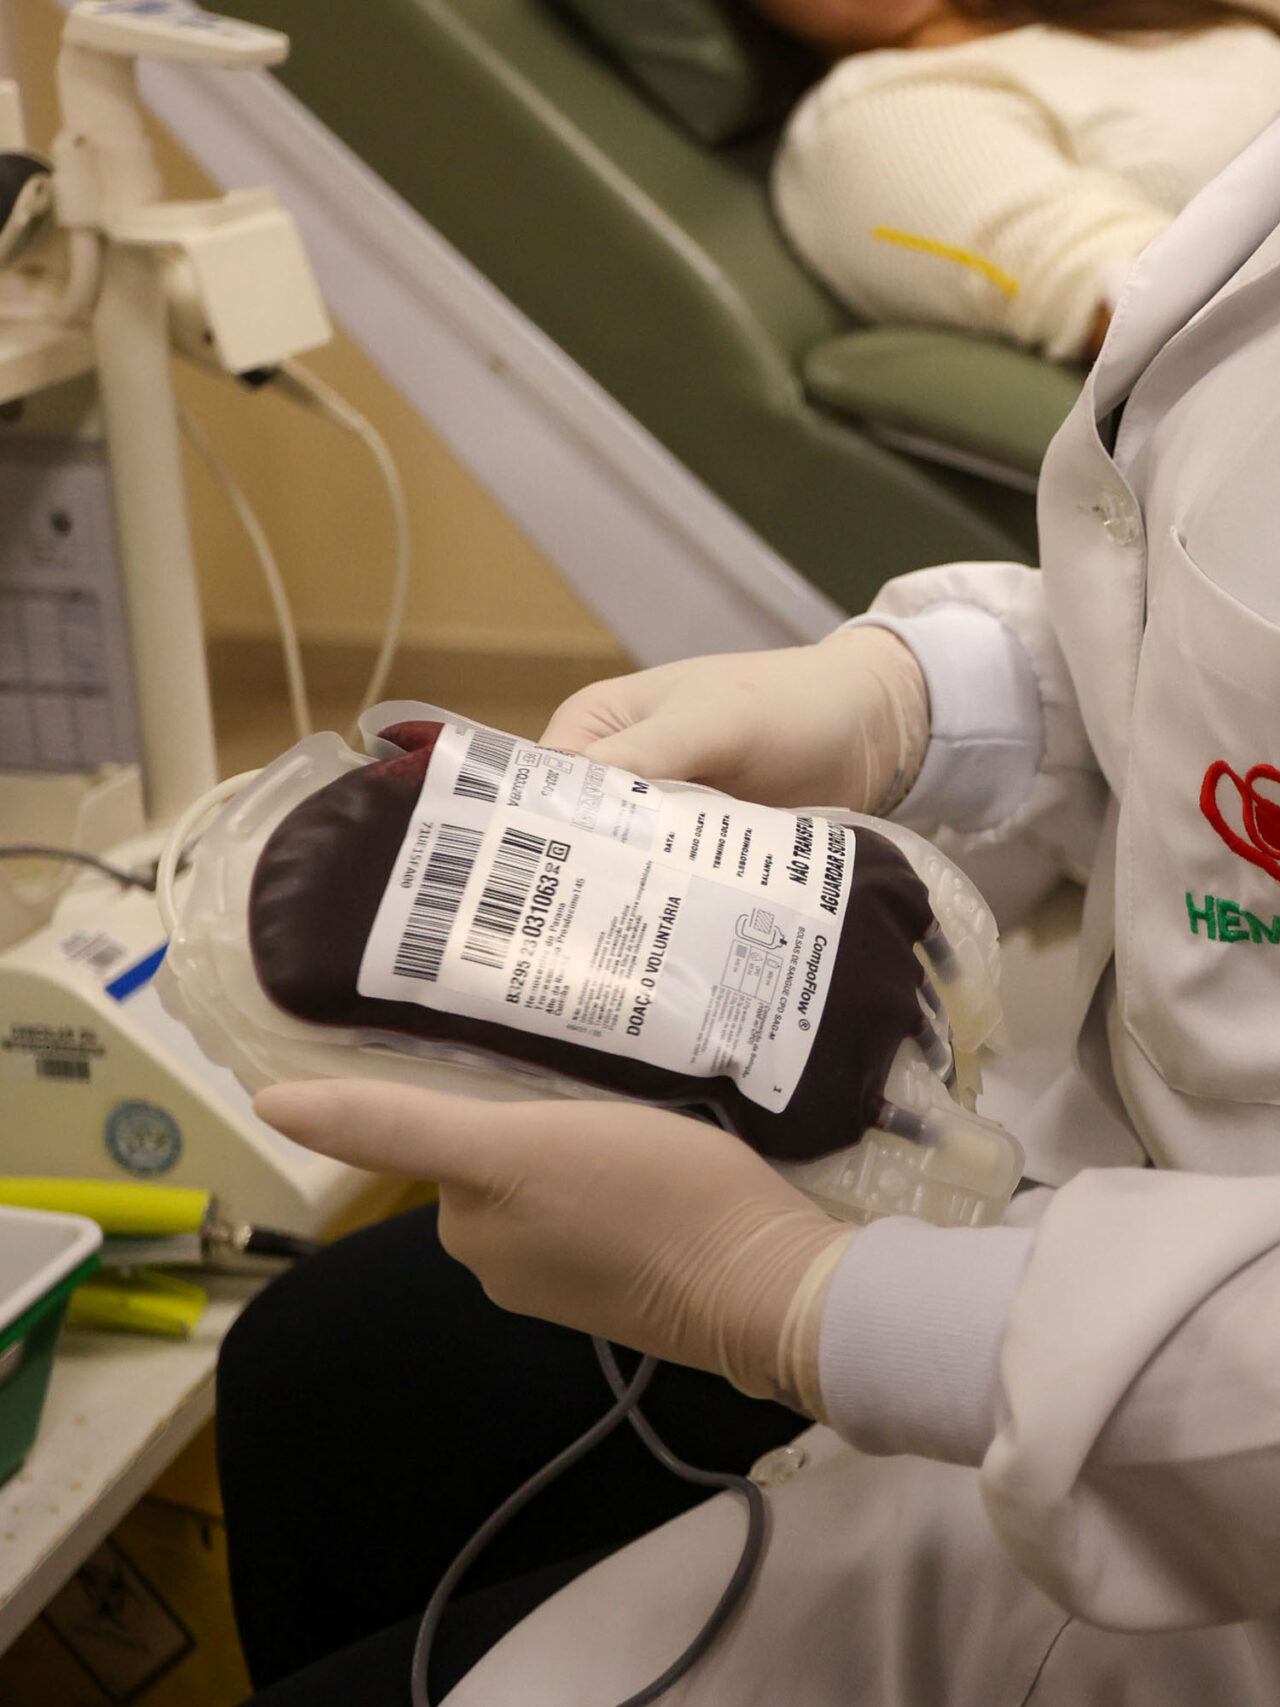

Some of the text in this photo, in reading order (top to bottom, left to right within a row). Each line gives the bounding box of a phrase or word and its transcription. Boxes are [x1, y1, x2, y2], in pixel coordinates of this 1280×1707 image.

[663, 830, 676, 853] DATA:
[760, 853, 774, 886] BALANÇA:
[787, 860, 809, 885] NÃO
[819, 854, 844, 915] AGUARDAR
[521, 873, 560, 939] 031063
[792, 925, 806, 954] BOLSAS
[553, 966, 566, 983] Ru
[625, 976, 656, 1037] DOAÇO
[644, 893, 681, 975] VOLUNTÁRIA
[789, 954, 799, 965] DE
[797, 935, 828, 1014] CompoFlow
[780, 964, 796, 996] SANGUE
[775, 995, 787, 1013] CPD
